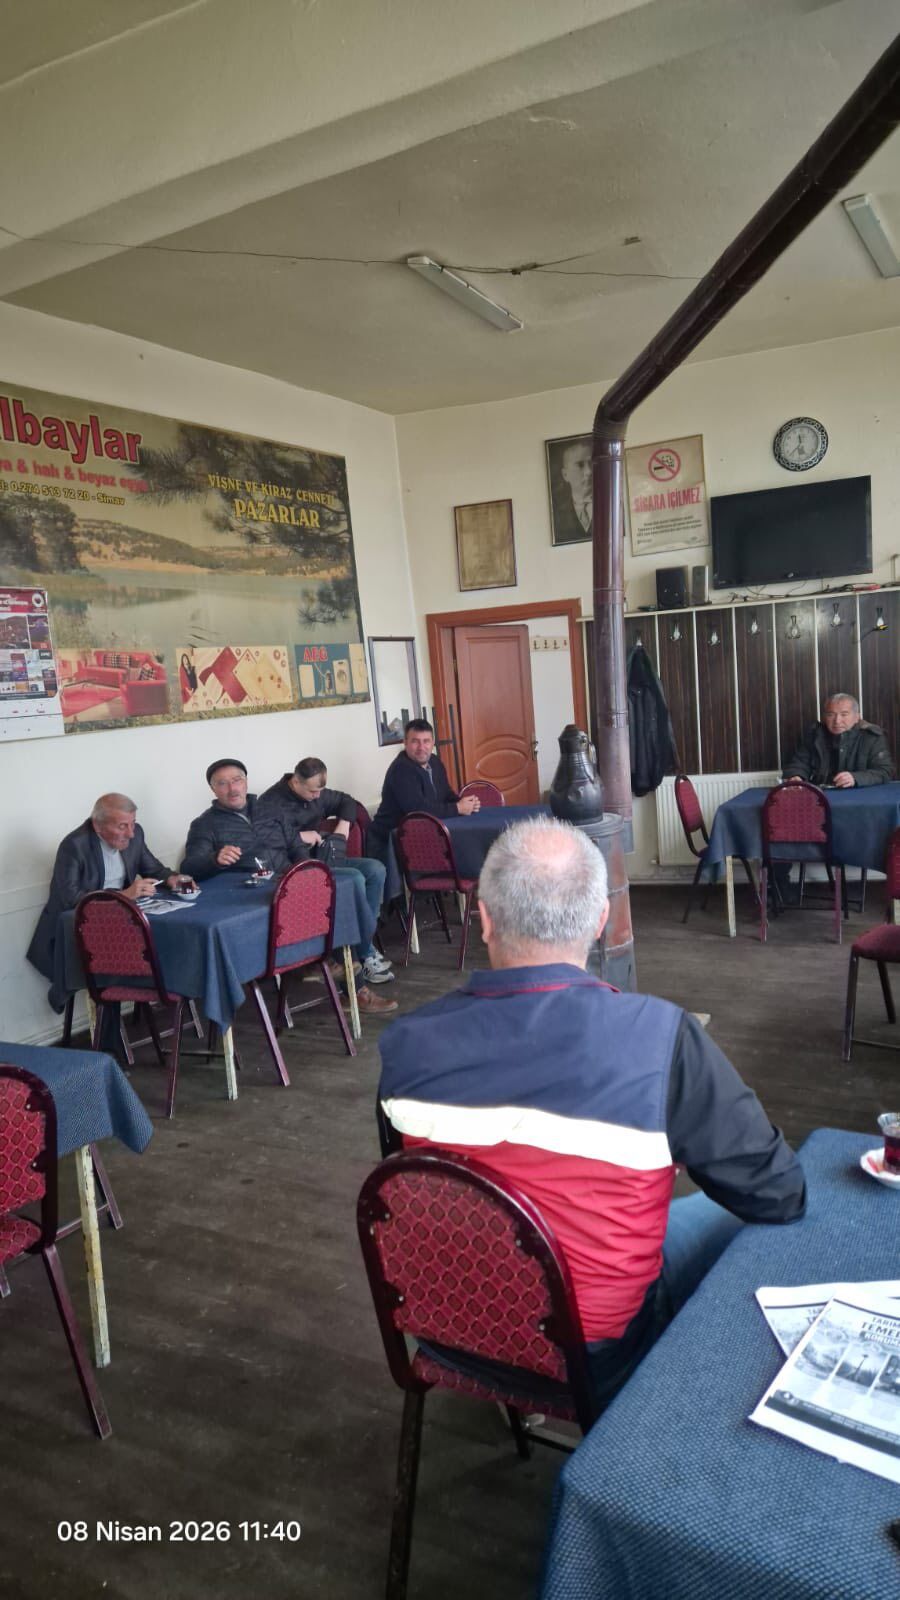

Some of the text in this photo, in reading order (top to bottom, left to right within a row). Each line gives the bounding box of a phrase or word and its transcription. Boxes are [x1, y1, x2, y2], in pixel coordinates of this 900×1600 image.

[0, 396, 141, 464] lbaylar
[245, 480, 258, 493] VE
[261, 481, 292, 499] KİRAZ
[234, 498, 320, 528] PAZARLAR
[864, 1333, 900, 1347] KORUM
